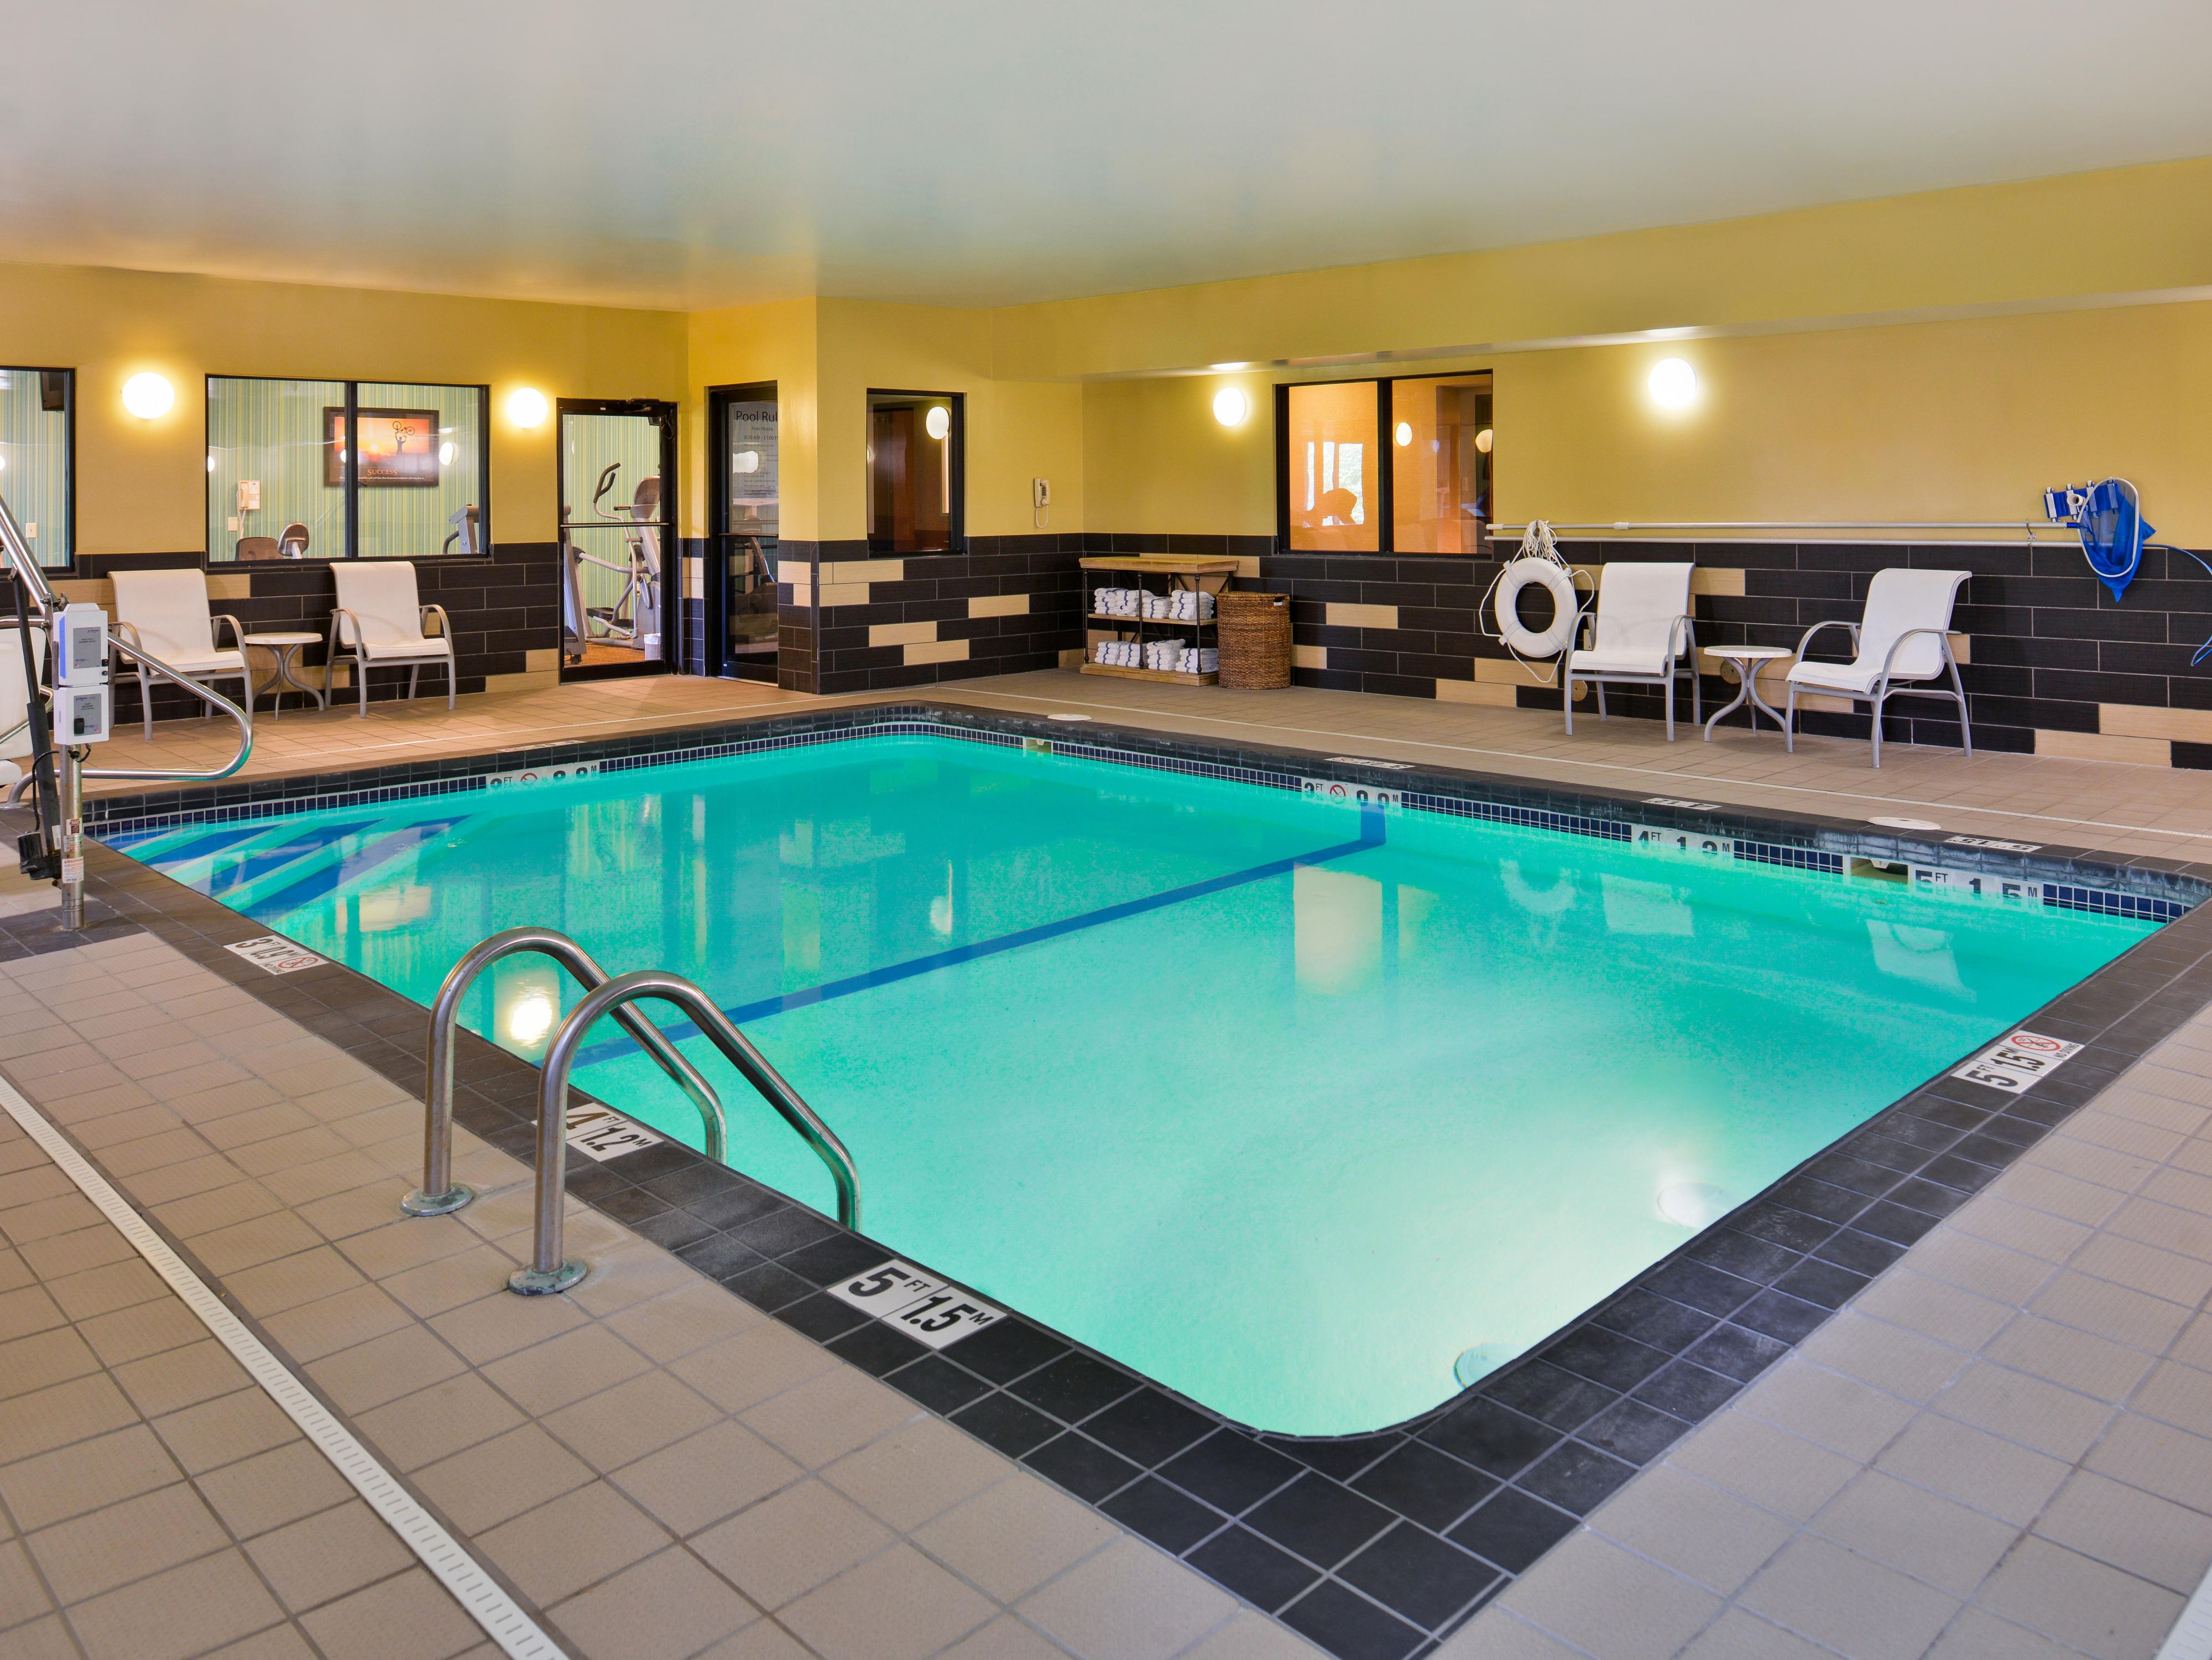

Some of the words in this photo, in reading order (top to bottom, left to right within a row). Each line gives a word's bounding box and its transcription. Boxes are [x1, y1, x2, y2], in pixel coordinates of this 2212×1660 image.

[736, 411, 758, 421] Pool
[1392, 794, 1399, 803] M
[1651, 832, 1661, 841] FT
[1722, 842, 1730, 852] M
[1936, 872, 1948, 883] FT
[2028, 886, 2037, 897] M
[235, 939, 273, 948] 3
[1990, 1052, 2045, 1071] 1.5
[1965, 1070, 2018, 1087] 5
[580, 1127, 640, 1152] 1.2
[633, 1138, 652, 1147] M
[848, 1267, 911, 1297] 5
[904, 1279, 931, 1292] FT
[900, 1297, 978, 1331] 1.5
[969, 1312, 994, 1325] M
